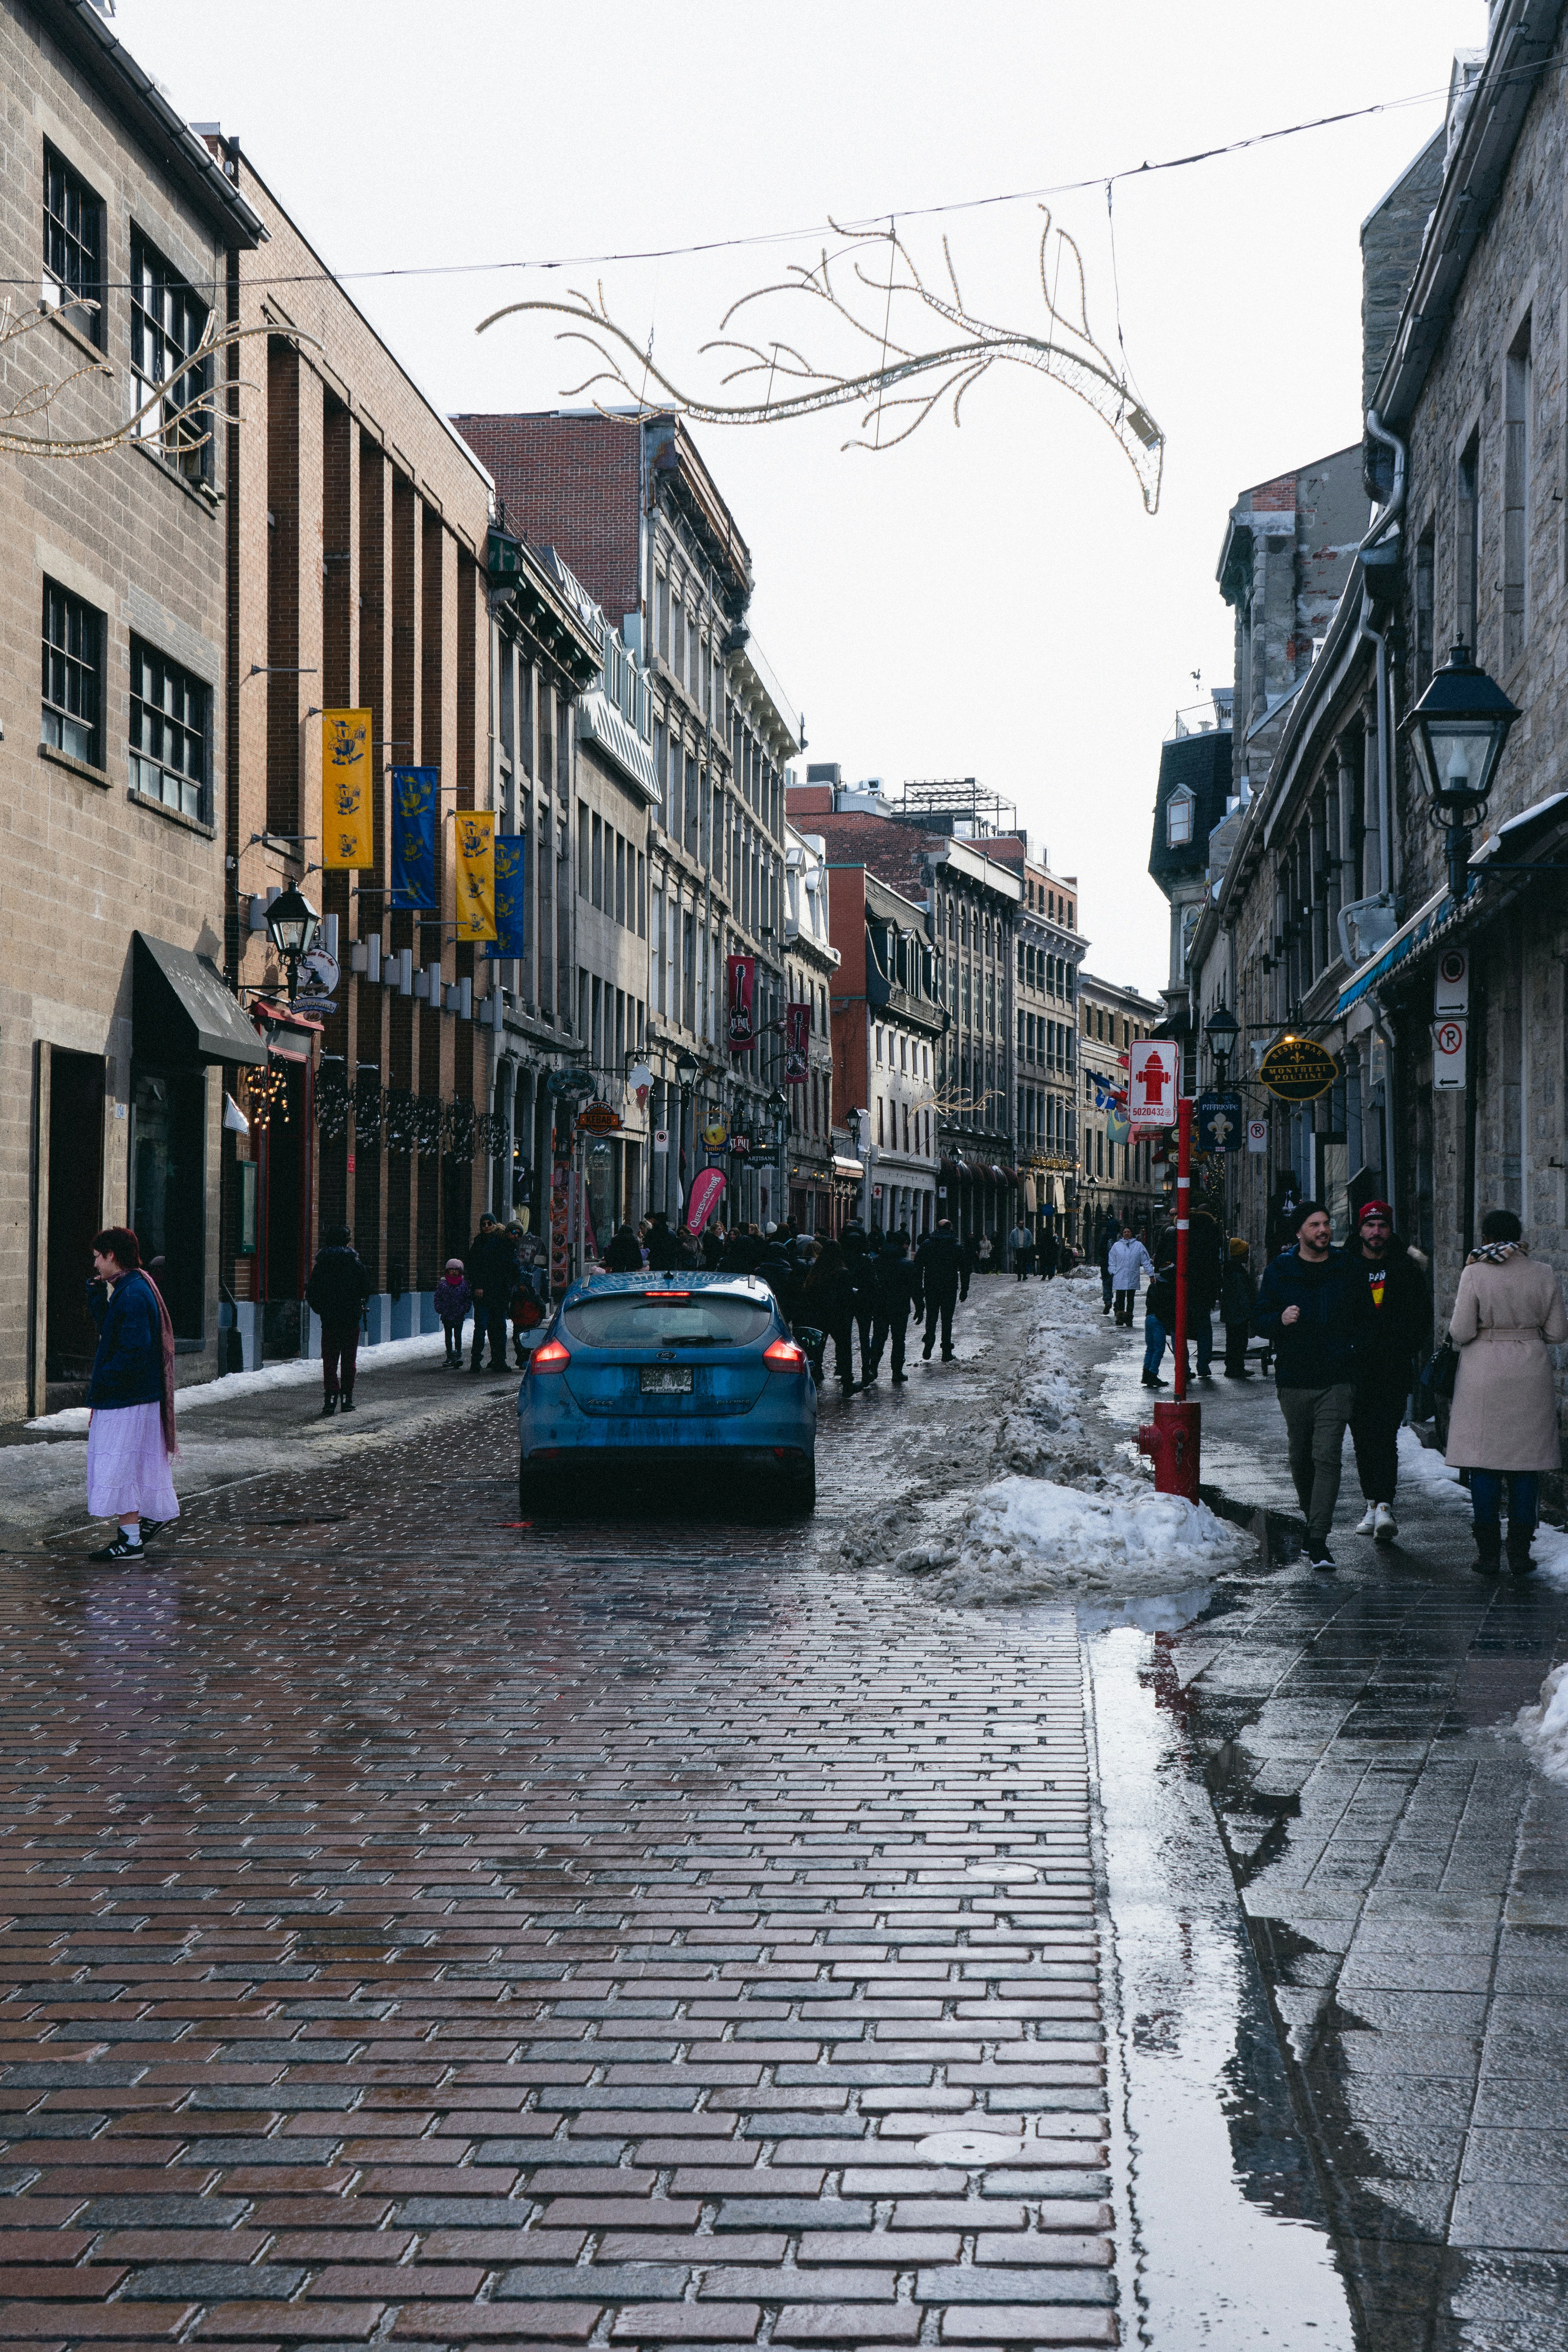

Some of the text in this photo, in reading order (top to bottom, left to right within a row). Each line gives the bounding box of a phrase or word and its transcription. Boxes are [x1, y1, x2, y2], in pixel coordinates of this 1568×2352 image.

[292, 1000, 334, 1010] Club Bavarois
[737, 1018, 750, 1033] PAUL
[1272, 1043, 1323, 1059] RESTO BAR
[1269, 1066, 1327, 1074] MONTREAL
[1275, 1073, 1323, 1081] POUTINE
[586, 1104, 612, 1113] MONTREAL
[1133, 1108, 1164, 1116] 5020432
[586, 1116, 612, 1124] KEBAB
[738, 1139, 750, 1152] PAUL
[690, 1202, 706, 1227] QUEUES
[1368, 1270, 1386, 1282] PAÑ
